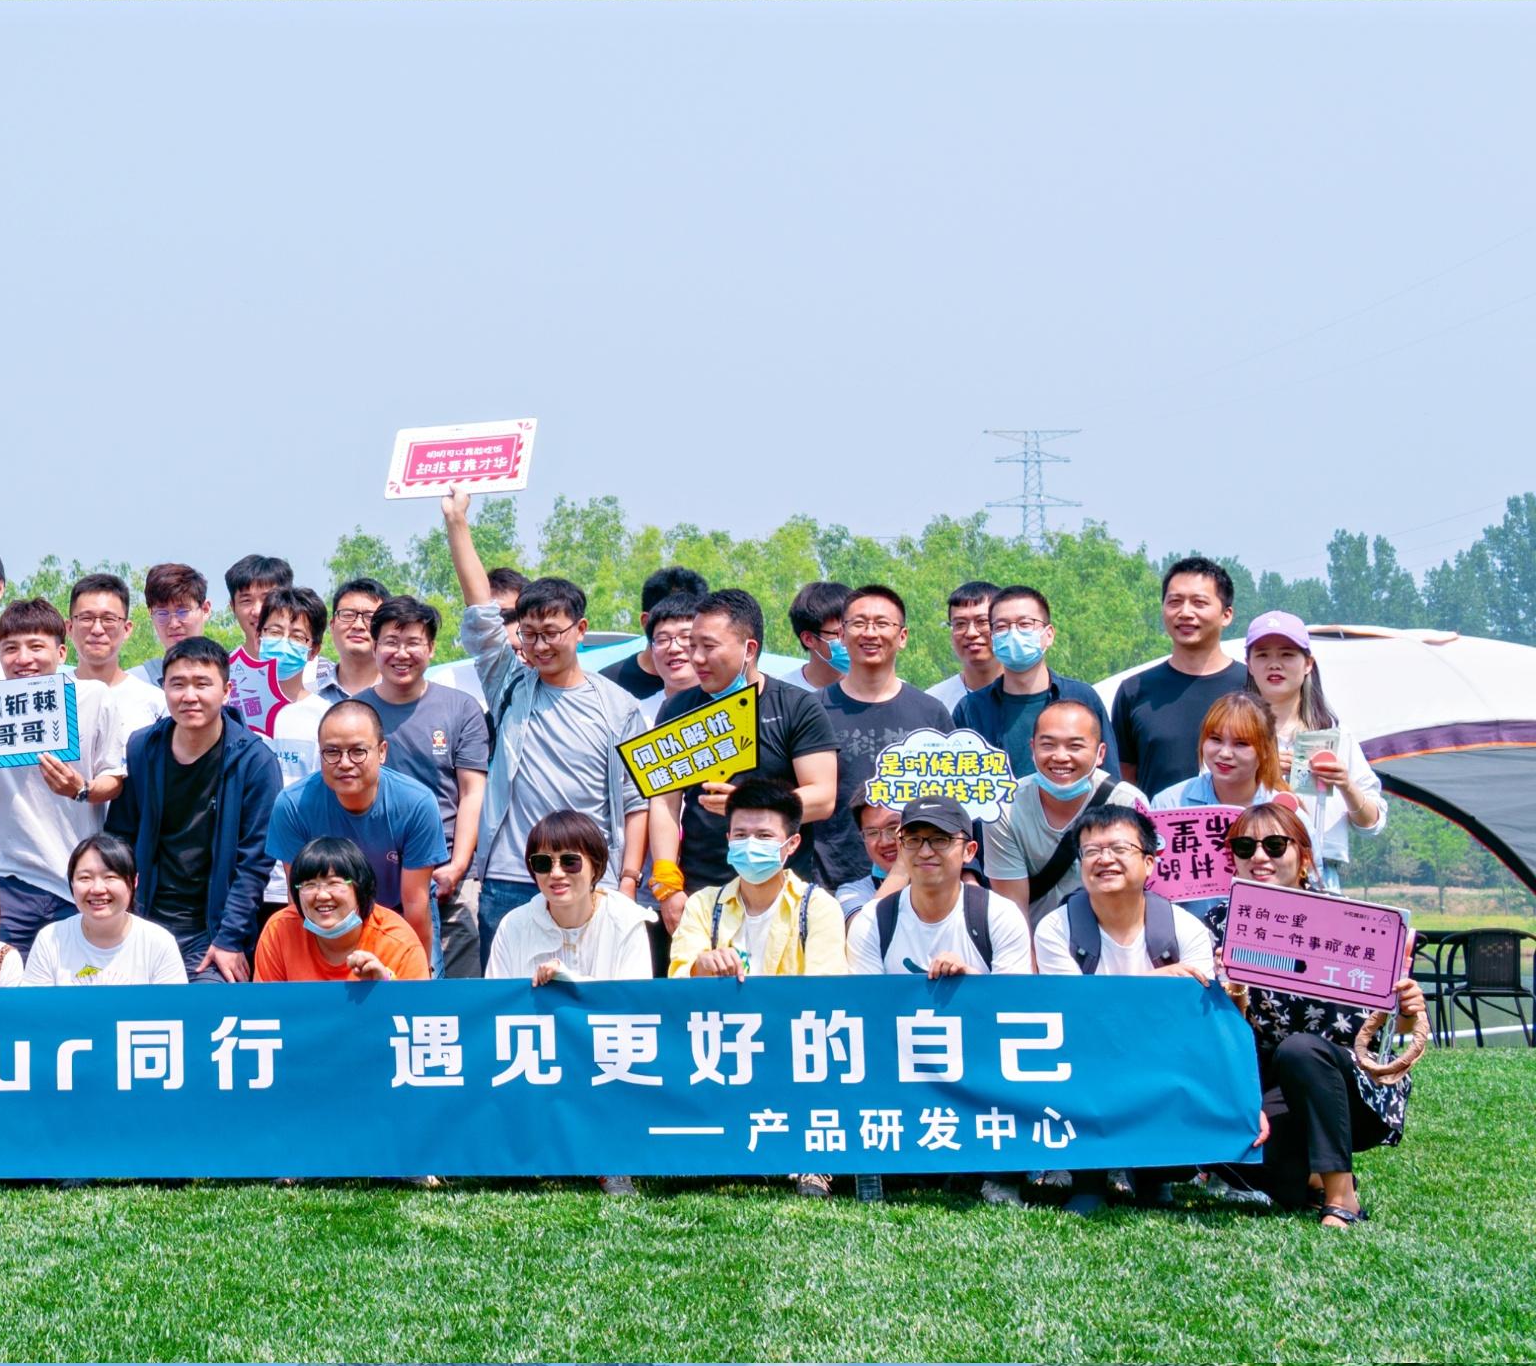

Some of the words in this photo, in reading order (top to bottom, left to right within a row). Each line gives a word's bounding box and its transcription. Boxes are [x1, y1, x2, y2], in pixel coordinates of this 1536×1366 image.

[416, 456, 509, 476] 却非要靠才华
[632, 710, 735, 770] 何以解忧
[646, 736, 739, 791] 唯有暴富
[879, 751, 1008, 777] 是时候展现
[868, 779, 1019, 804] 真正的技术了
[1236, 923, 1376, 962] 只有一件事那就是
[1320, 965, 1375, 992] 工作
[389, 1009, 1076, 1091] 遇见更好的自己
